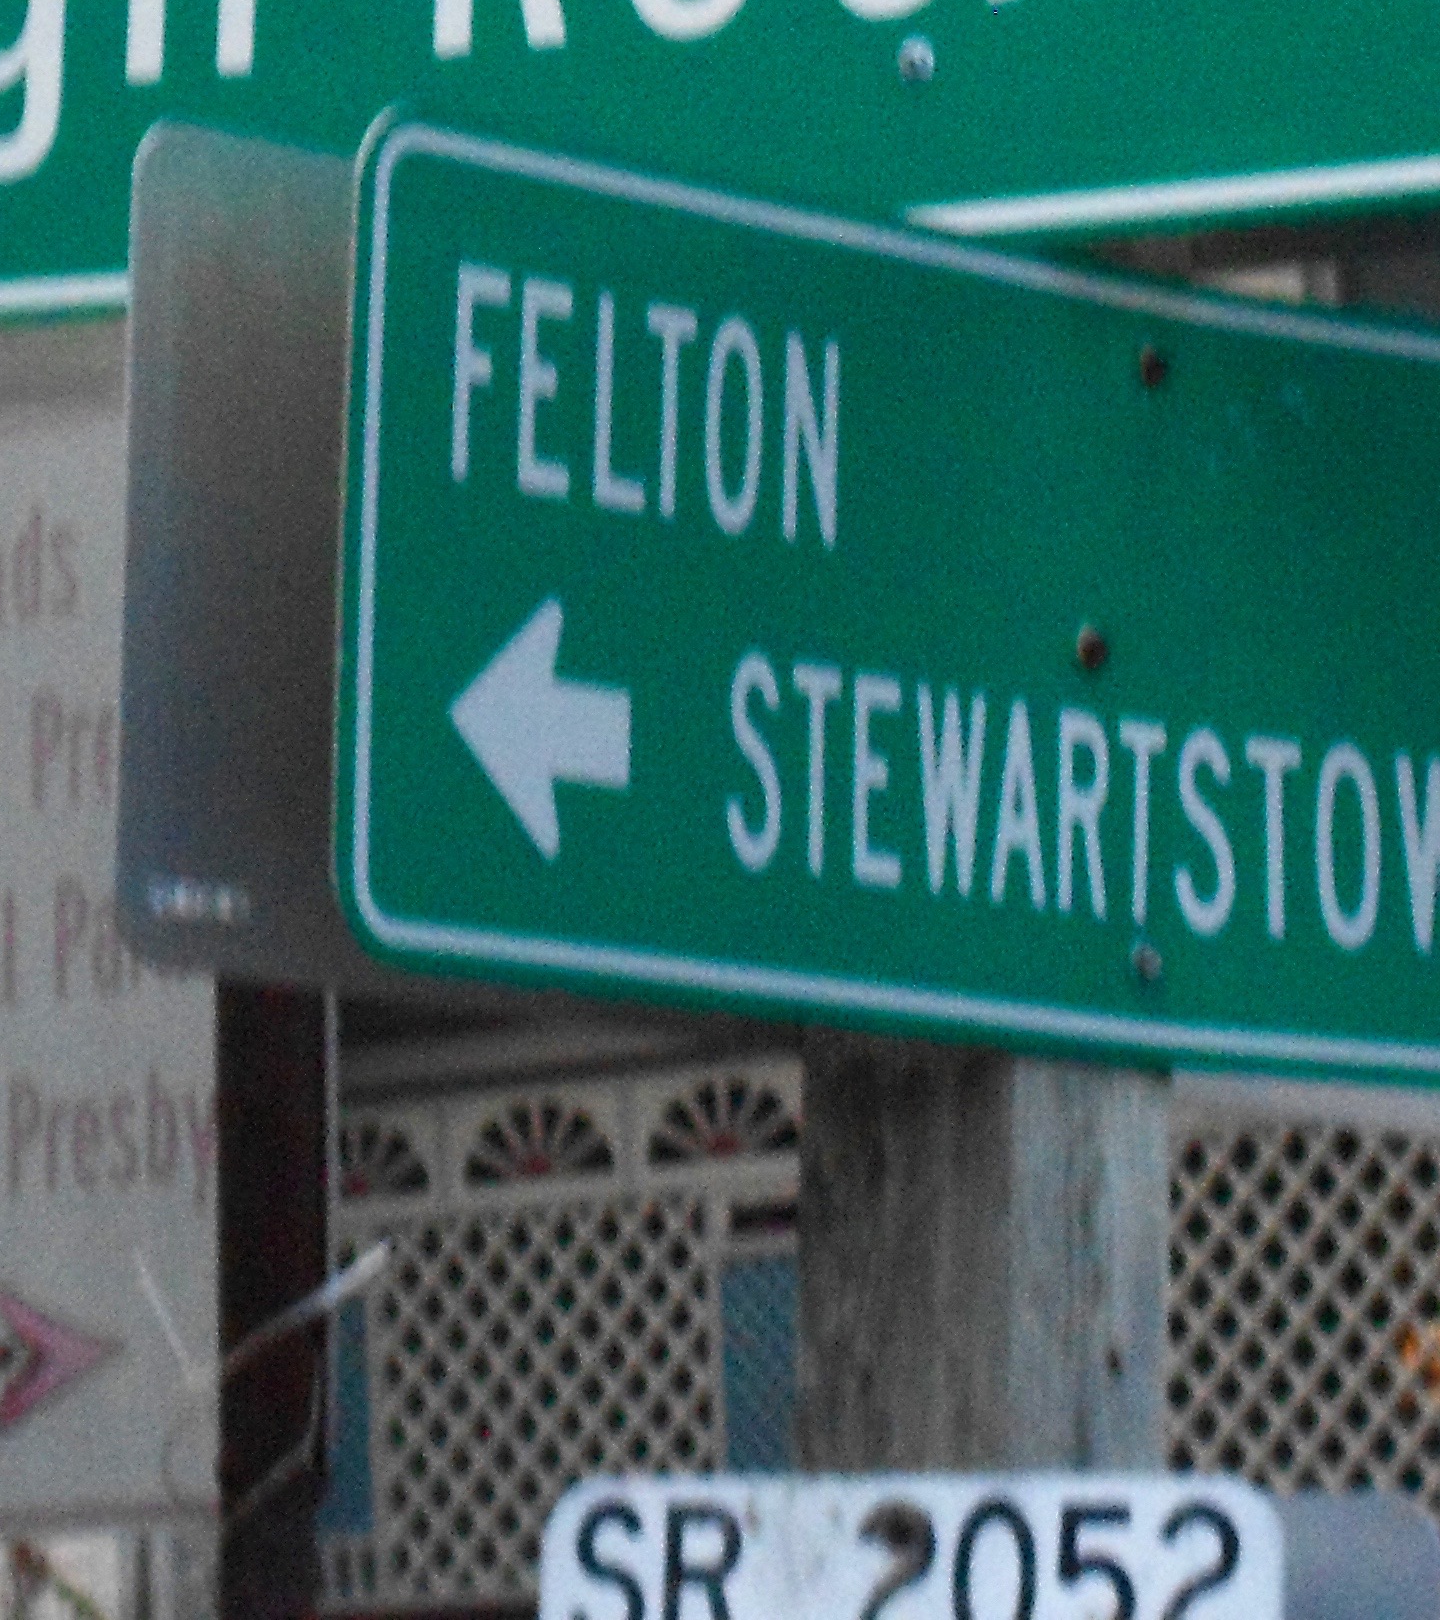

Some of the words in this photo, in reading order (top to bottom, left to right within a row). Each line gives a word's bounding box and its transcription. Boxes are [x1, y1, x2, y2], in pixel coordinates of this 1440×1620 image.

[451, 260, 840, 548] FELTON
[573, 1497, 743, 1620] SR
[857, 1493, 1242, 1620] 2052
